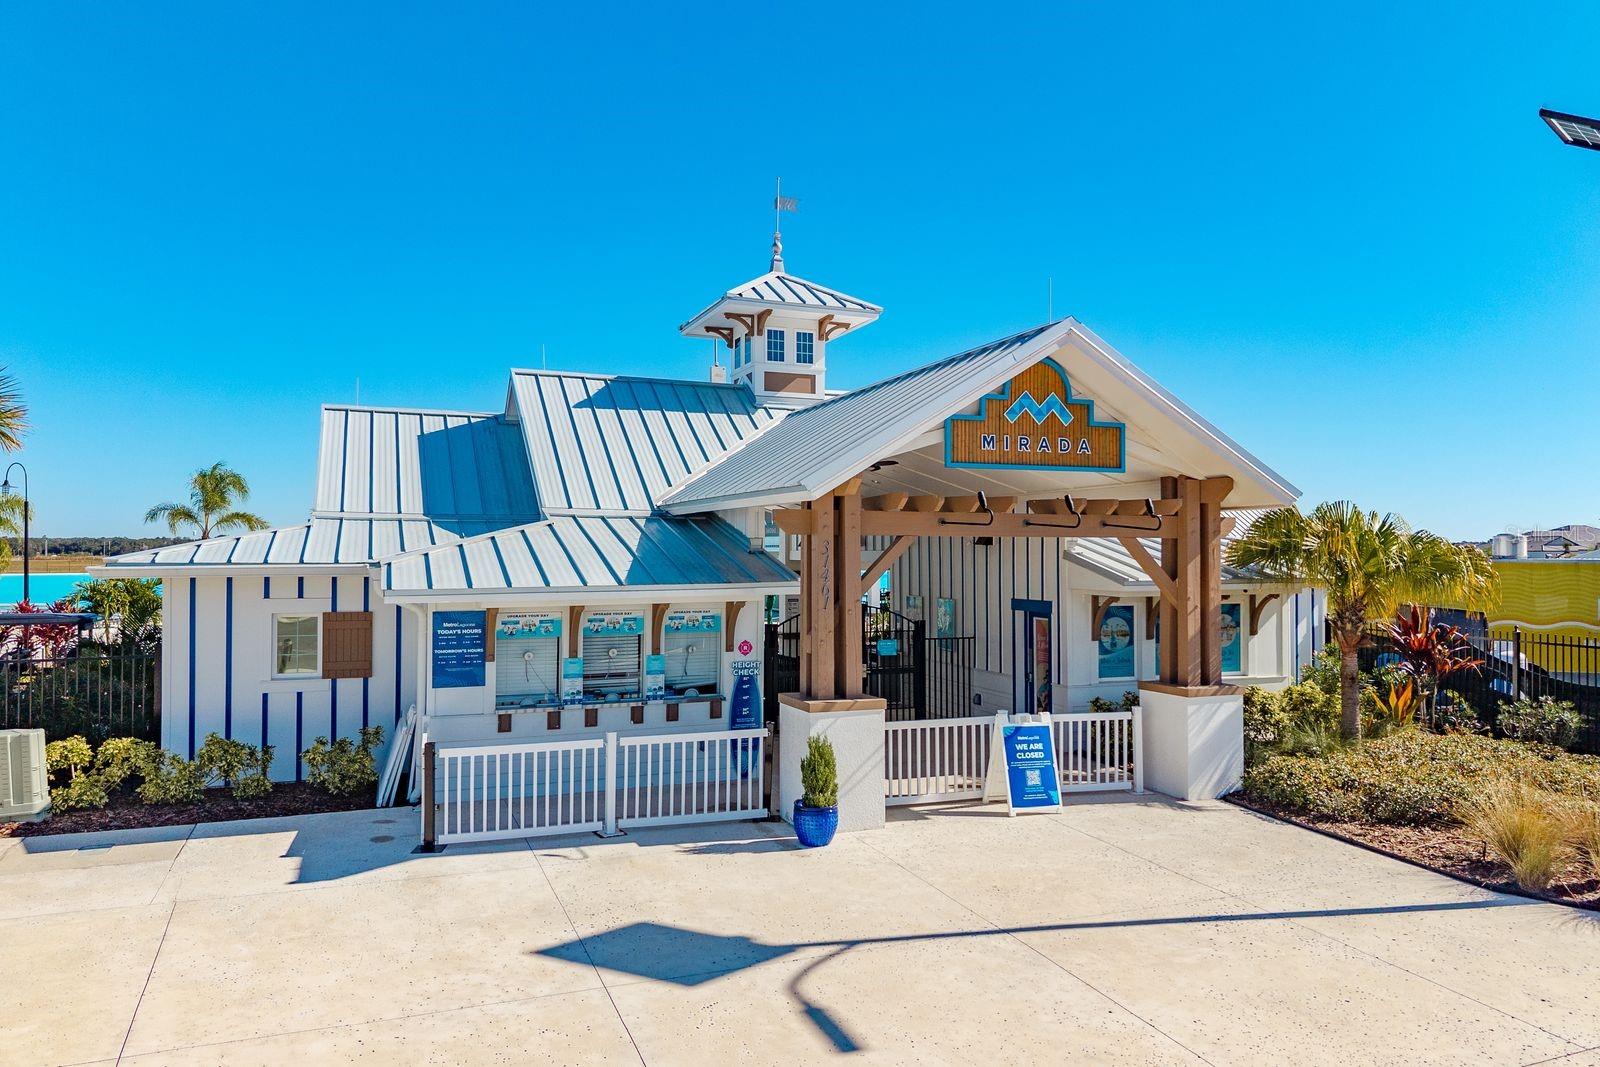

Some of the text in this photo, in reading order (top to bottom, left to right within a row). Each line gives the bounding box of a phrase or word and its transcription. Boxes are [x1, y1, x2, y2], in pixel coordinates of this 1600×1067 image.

[981, 434, 1092, 454] MIRADA
[732, 661, 761, 669] HEIGHT
[733, 668, 760, 676] CHECK
